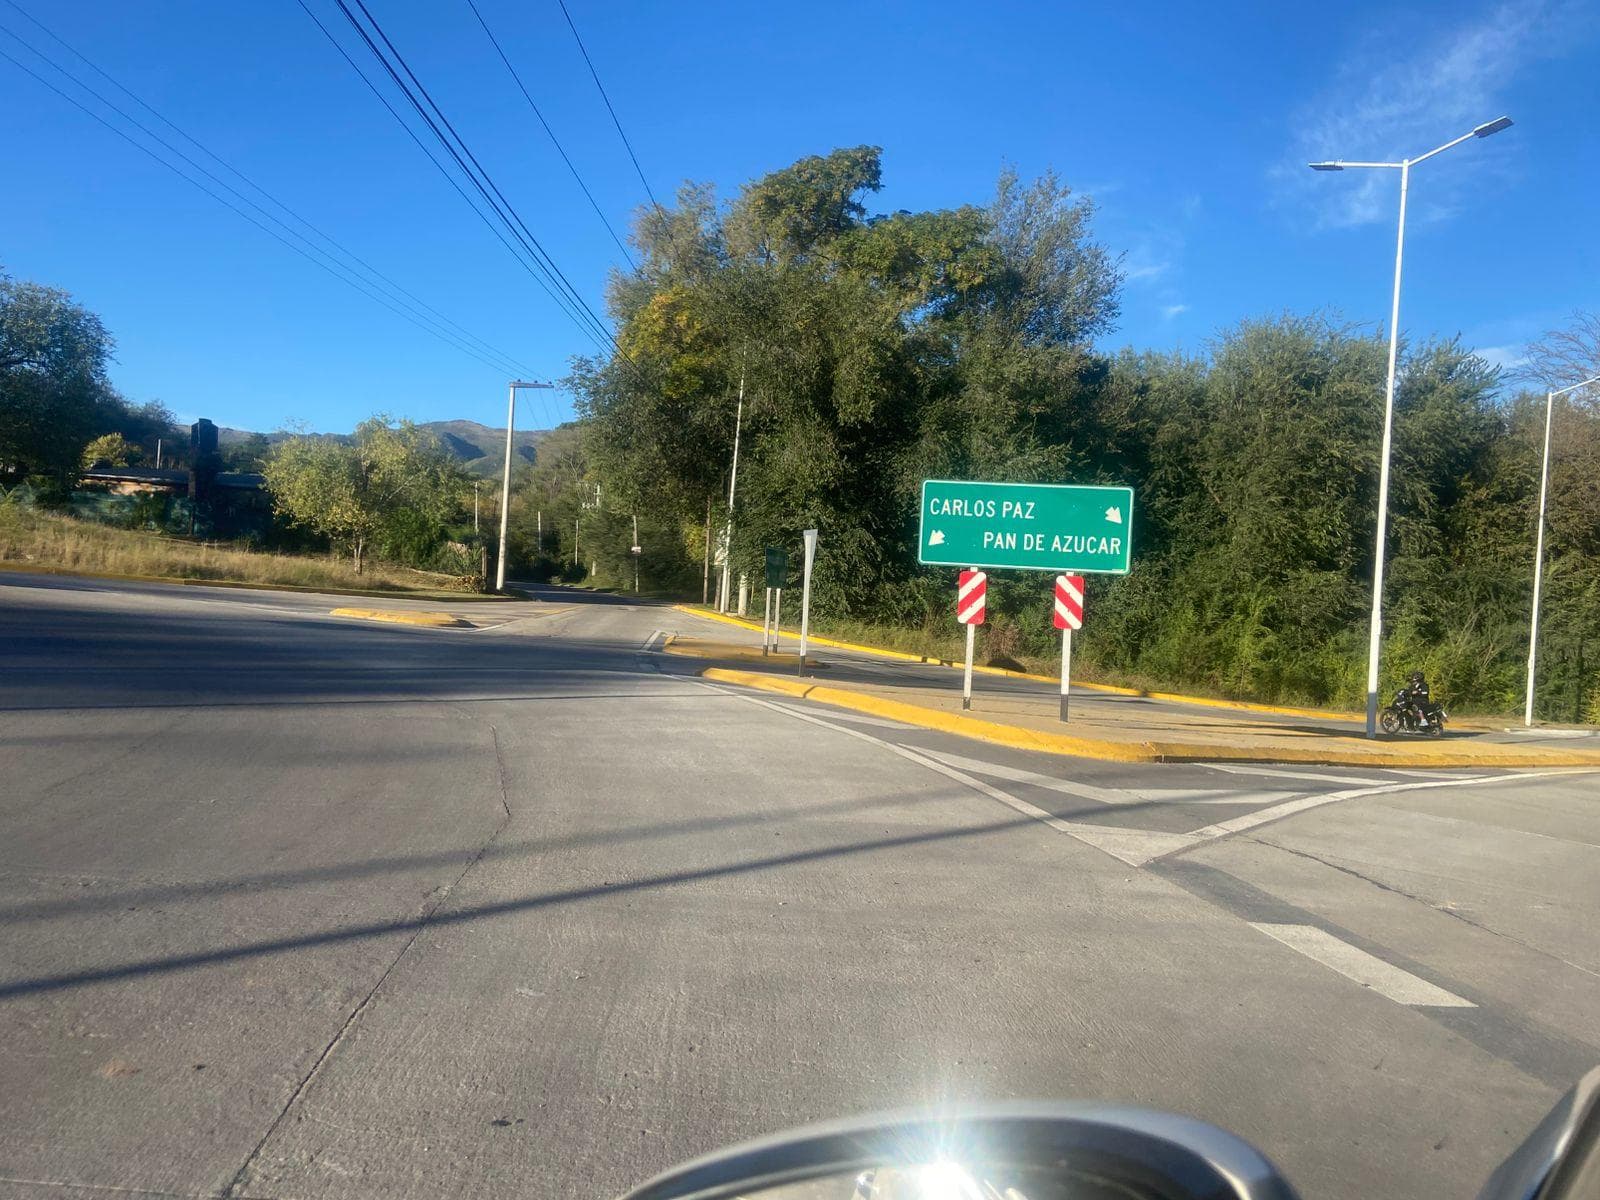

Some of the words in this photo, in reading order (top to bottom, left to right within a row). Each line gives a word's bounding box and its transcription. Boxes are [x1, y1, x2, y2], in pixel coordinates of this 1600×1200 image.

[930, 497, 996, 518] CARLOS
[1002, 501, 1035, 520] PAZ
[983, 531, 1017, 550] PAN
[1023, 533, 1045, 551] DE
[1051, 534, 1121, 555] AZUCAR
